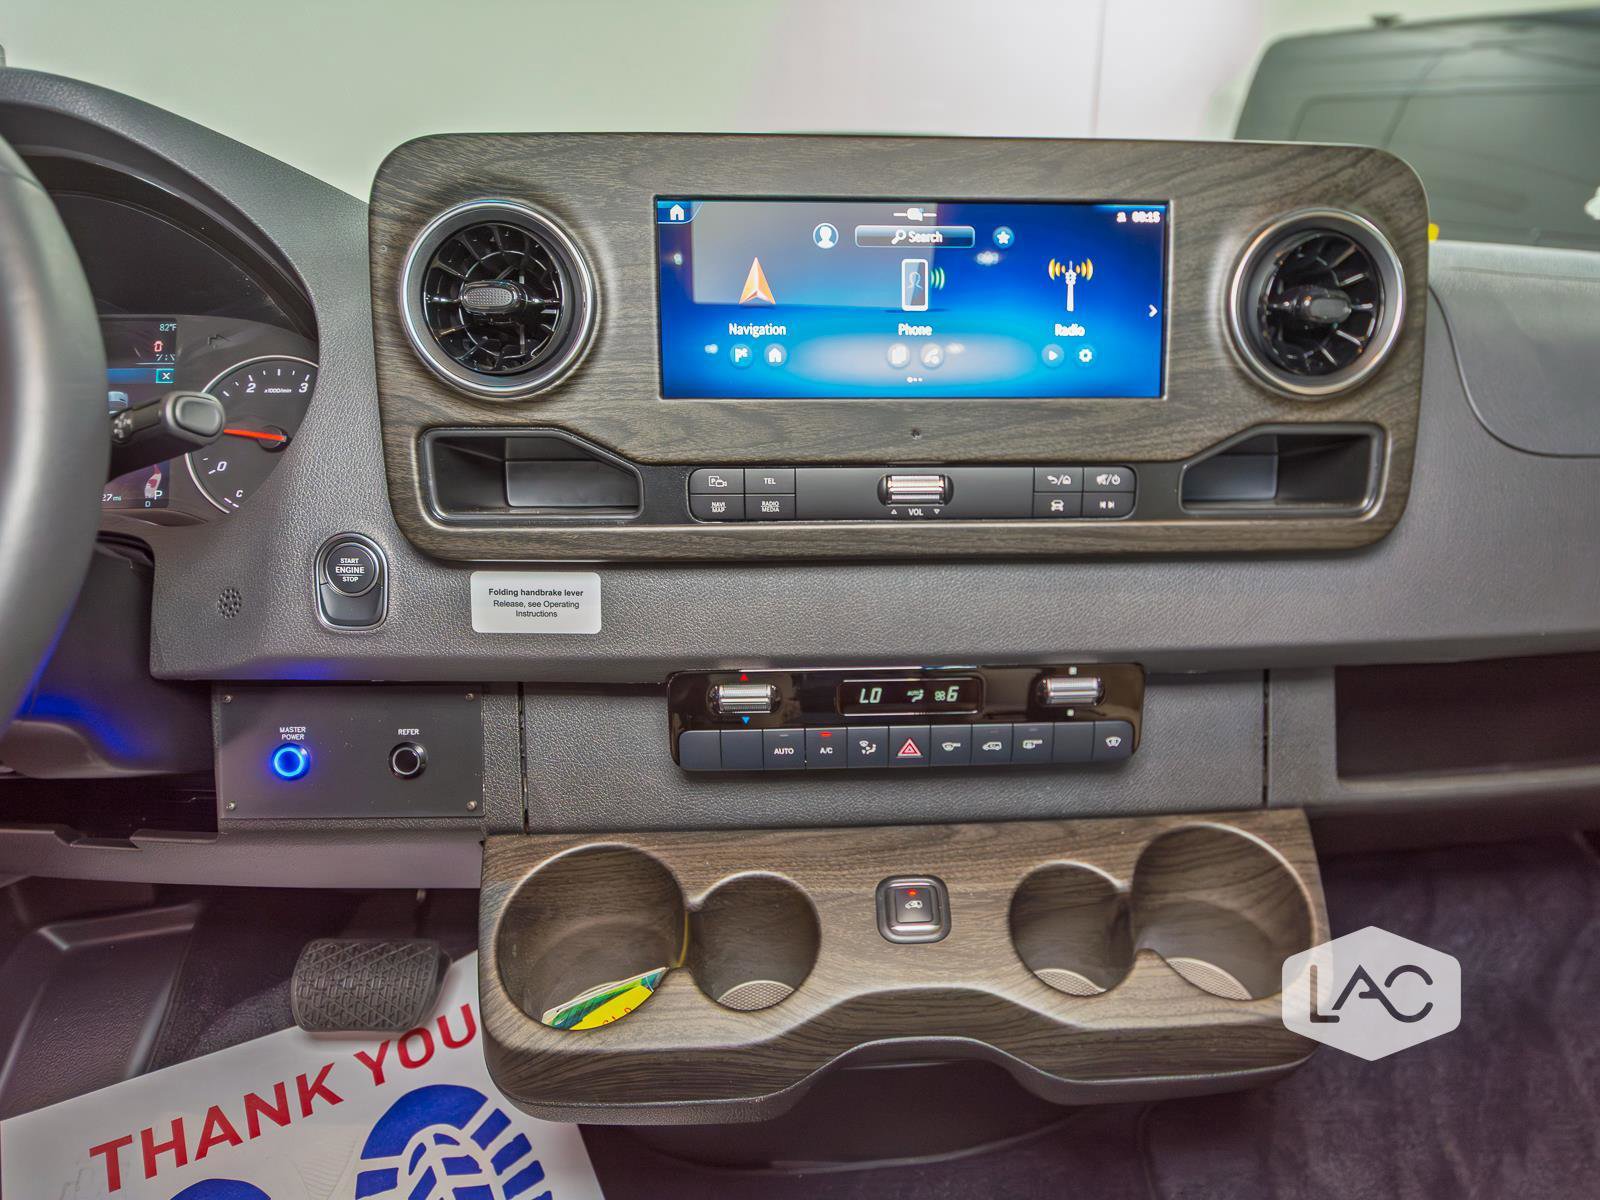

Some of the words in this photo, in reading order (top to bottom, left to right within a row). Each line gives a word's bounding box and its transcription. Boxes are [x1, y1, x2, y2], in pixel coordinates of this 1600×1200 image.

[908, 230, 943, 245] Search
[728, 322, 787, 337] Navigation
[897, 322, 932, 337] Phone
[1054, 322, 1085, 337] Radio
[245, 382, 257, 393] 2
[298, 382, 309, 393] 3
[763, 477, 776, 485] TEL
[154, 490, 163, 500] P
[908, 508, 924, 516] VOL
[335, 566, 365, 574] ENGINE
[488, 588, 519, 598] Folding
[520, 588, 562, 597] handbrake
[564, 588, 584, 597] lever
[493, 600, 526, 609] Release,
[543, 600, 580, 610] Operating
[515, 610, 558, 618] Instructions
[946, 686, 960, 702] 6
[398, 728, 420, 736] REFER
[774, 747, 795, 755] AUTO
[89, 1062, 345, 1193] THANK
[353, 1003, 477, 1087] YOU
